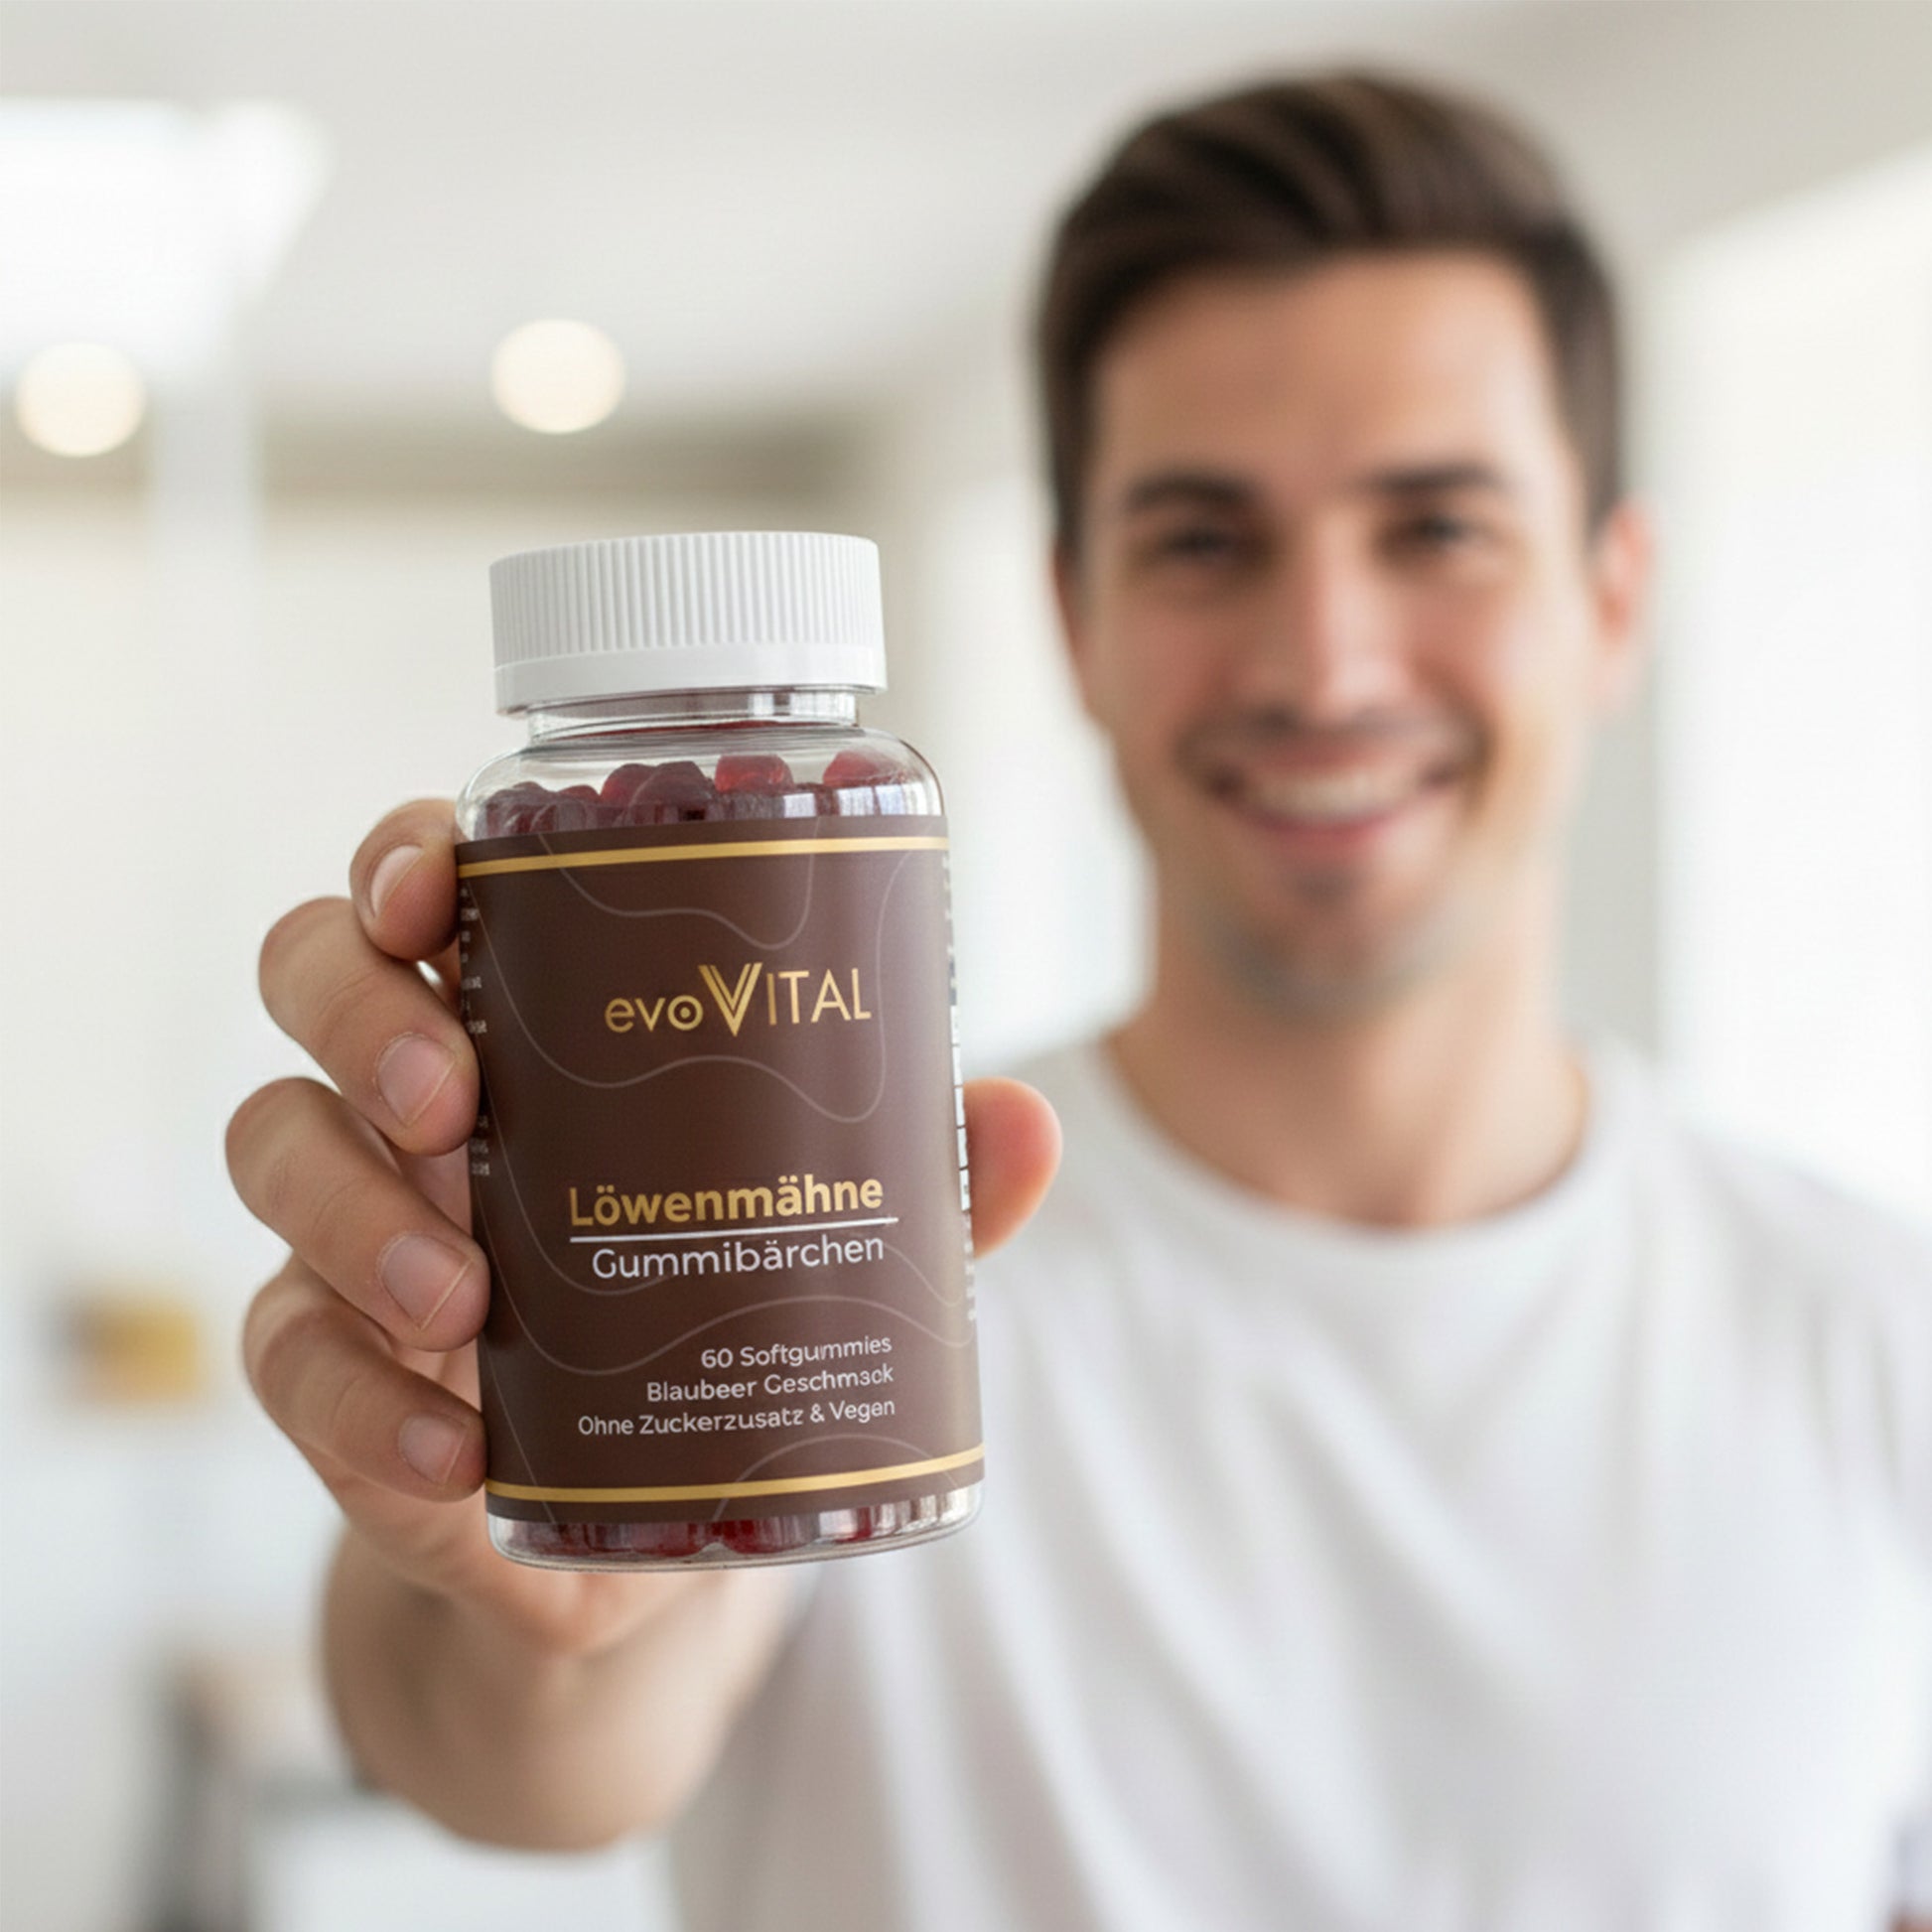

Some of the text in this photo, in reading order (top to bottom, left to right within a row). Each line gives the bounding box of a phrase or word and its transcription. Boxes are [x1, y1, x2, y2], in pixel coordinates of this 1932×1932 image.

[570, 1173, 884, 1227] Löwenmähne
[593, 1234, 885, 1279] Gummibärchen
[701, 1336, 892, 1369] 60 Softgummies
[647, 1378, 758, 1402] Blaubeer
[578, 1400, 896, 1436] Ohne Zuckerzusatz & Vegan
